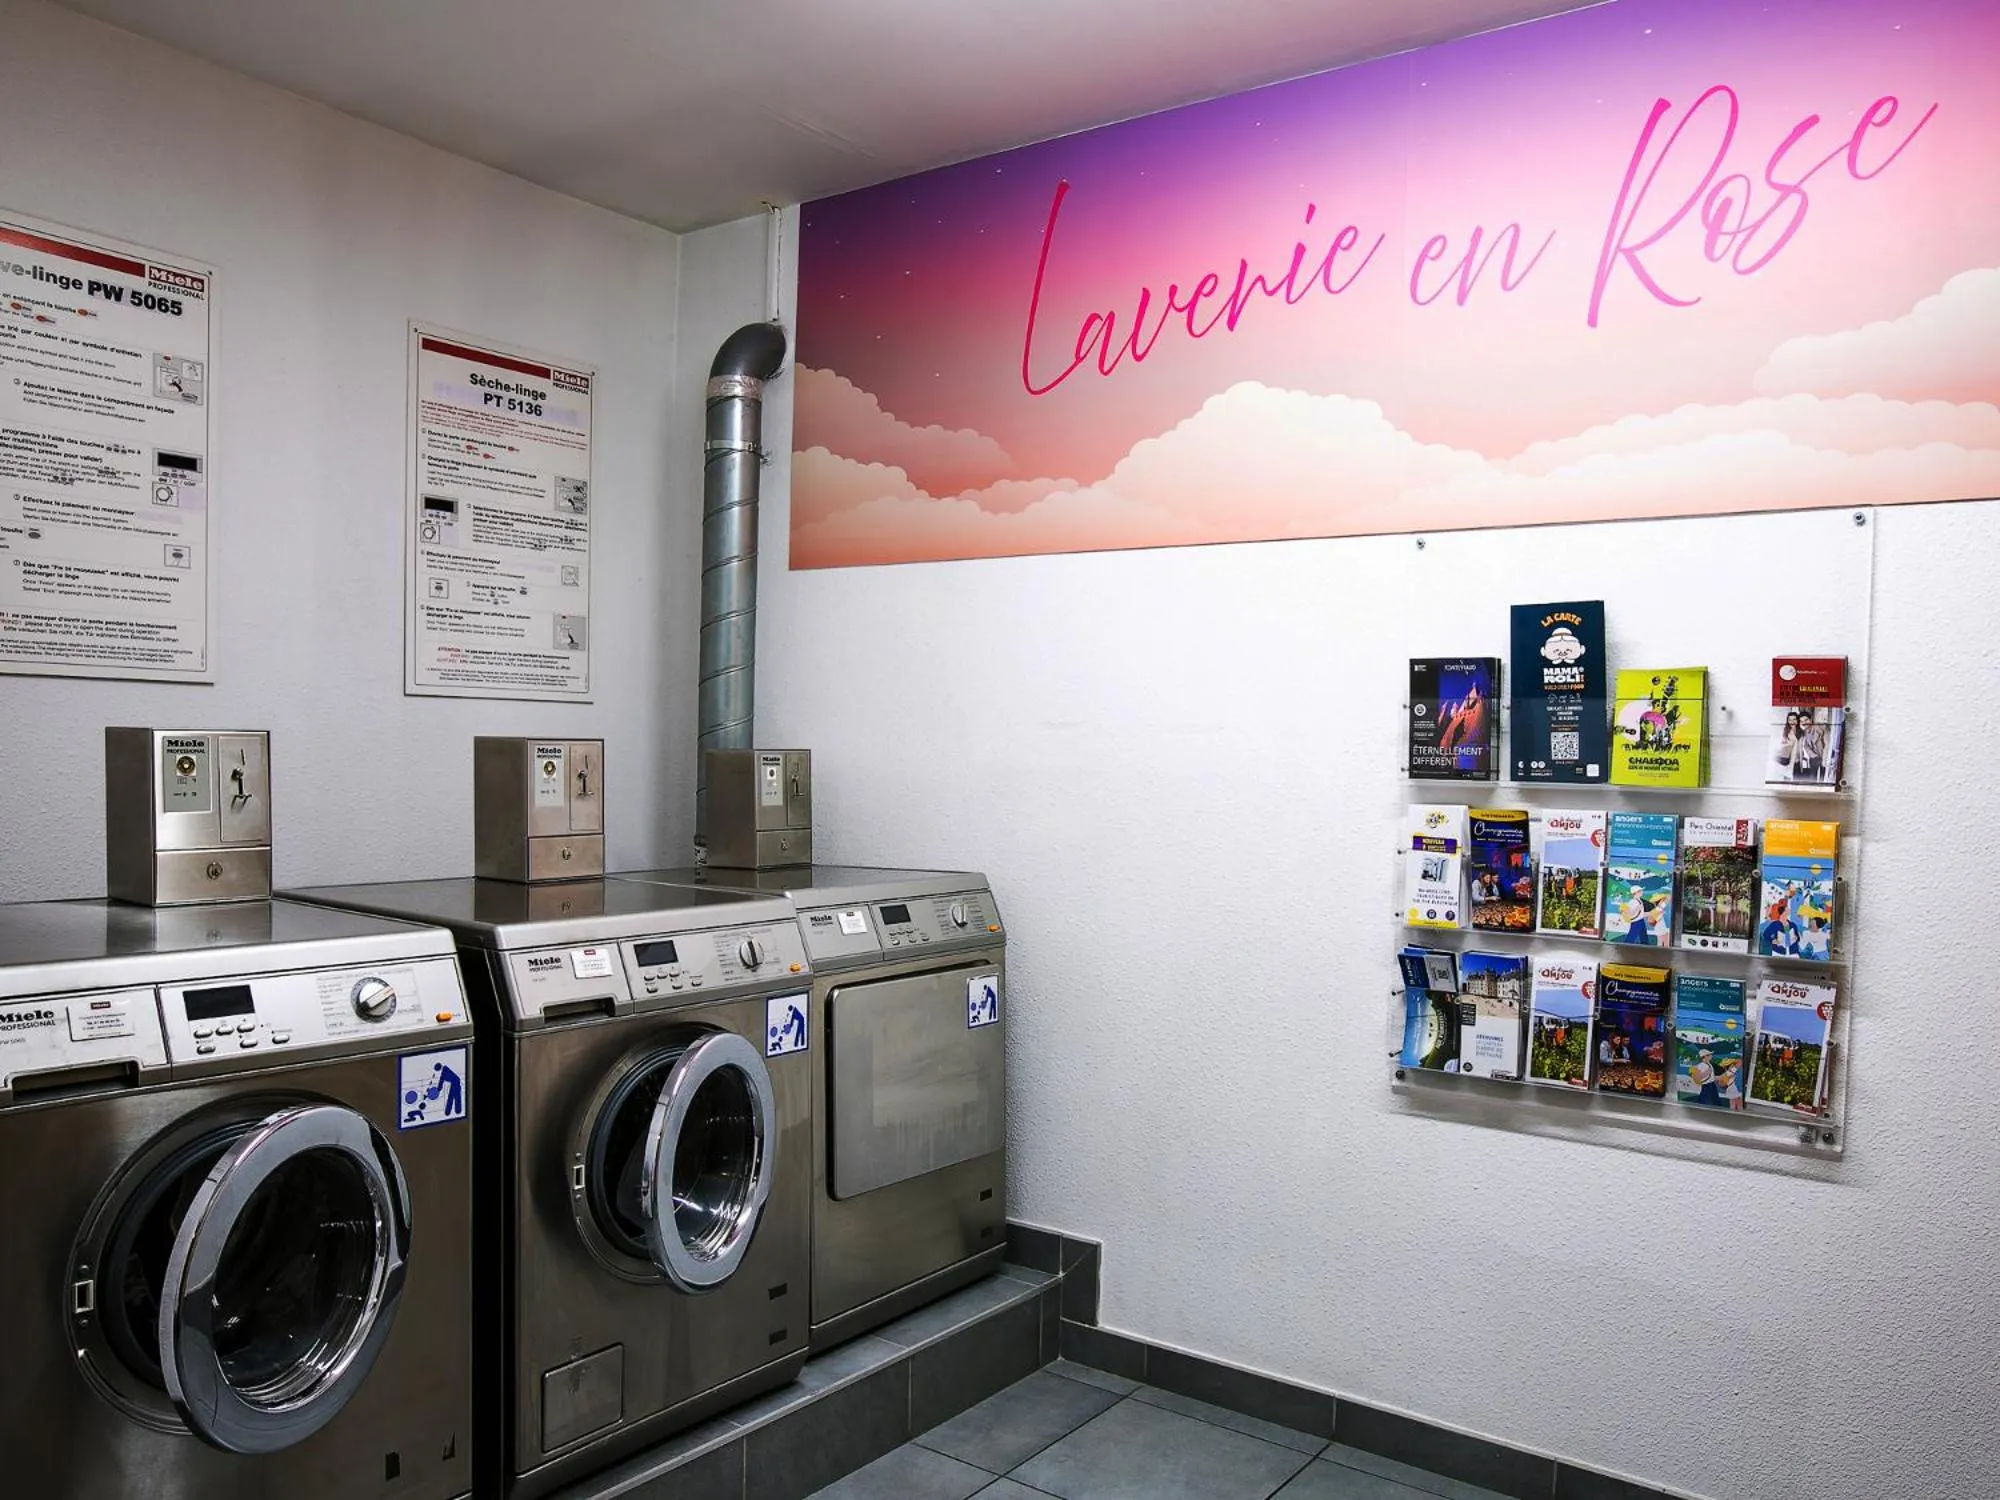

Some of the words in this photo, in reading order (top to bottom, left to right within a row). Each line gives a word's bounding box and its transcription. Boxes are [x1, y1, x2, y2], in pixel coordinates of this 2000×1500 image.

[1022, 181, 1384, 395] Laverie
[1410, 223, 1555, 306] en
[1587, 85, 1938, 328] Rose
[150, 268, 204, 294] Miele
[87, 279, 124, 303] PW
[130, 291, 184, 317] 5065
[148, 282, 205, 301] PROFESSIONAL
[469, 372, 547, 401] Sèche-linge
[553, 370, 590, 388] Miele
[483, 392, 504, 408] PT
[507, 398, 543, 418] 5136
[1540, 615, 1554, 628] LA
[1553, 612, 1583, 627] CARTE
[1543, 667, 1579, 676] MAMA
[167, 739, 205, 748] Miele
[1412, 744, 1484, 757] ÉTERNELLEMENT
[1412, 755, 1458, 769] DIFFÉRENT
[1689, 822, 1704, 830] Parc
[1705, 822, 1734, 832] Oriental
[528, 956, 562, 967] Miele
[0, 1009, 55, 1023] Miele
